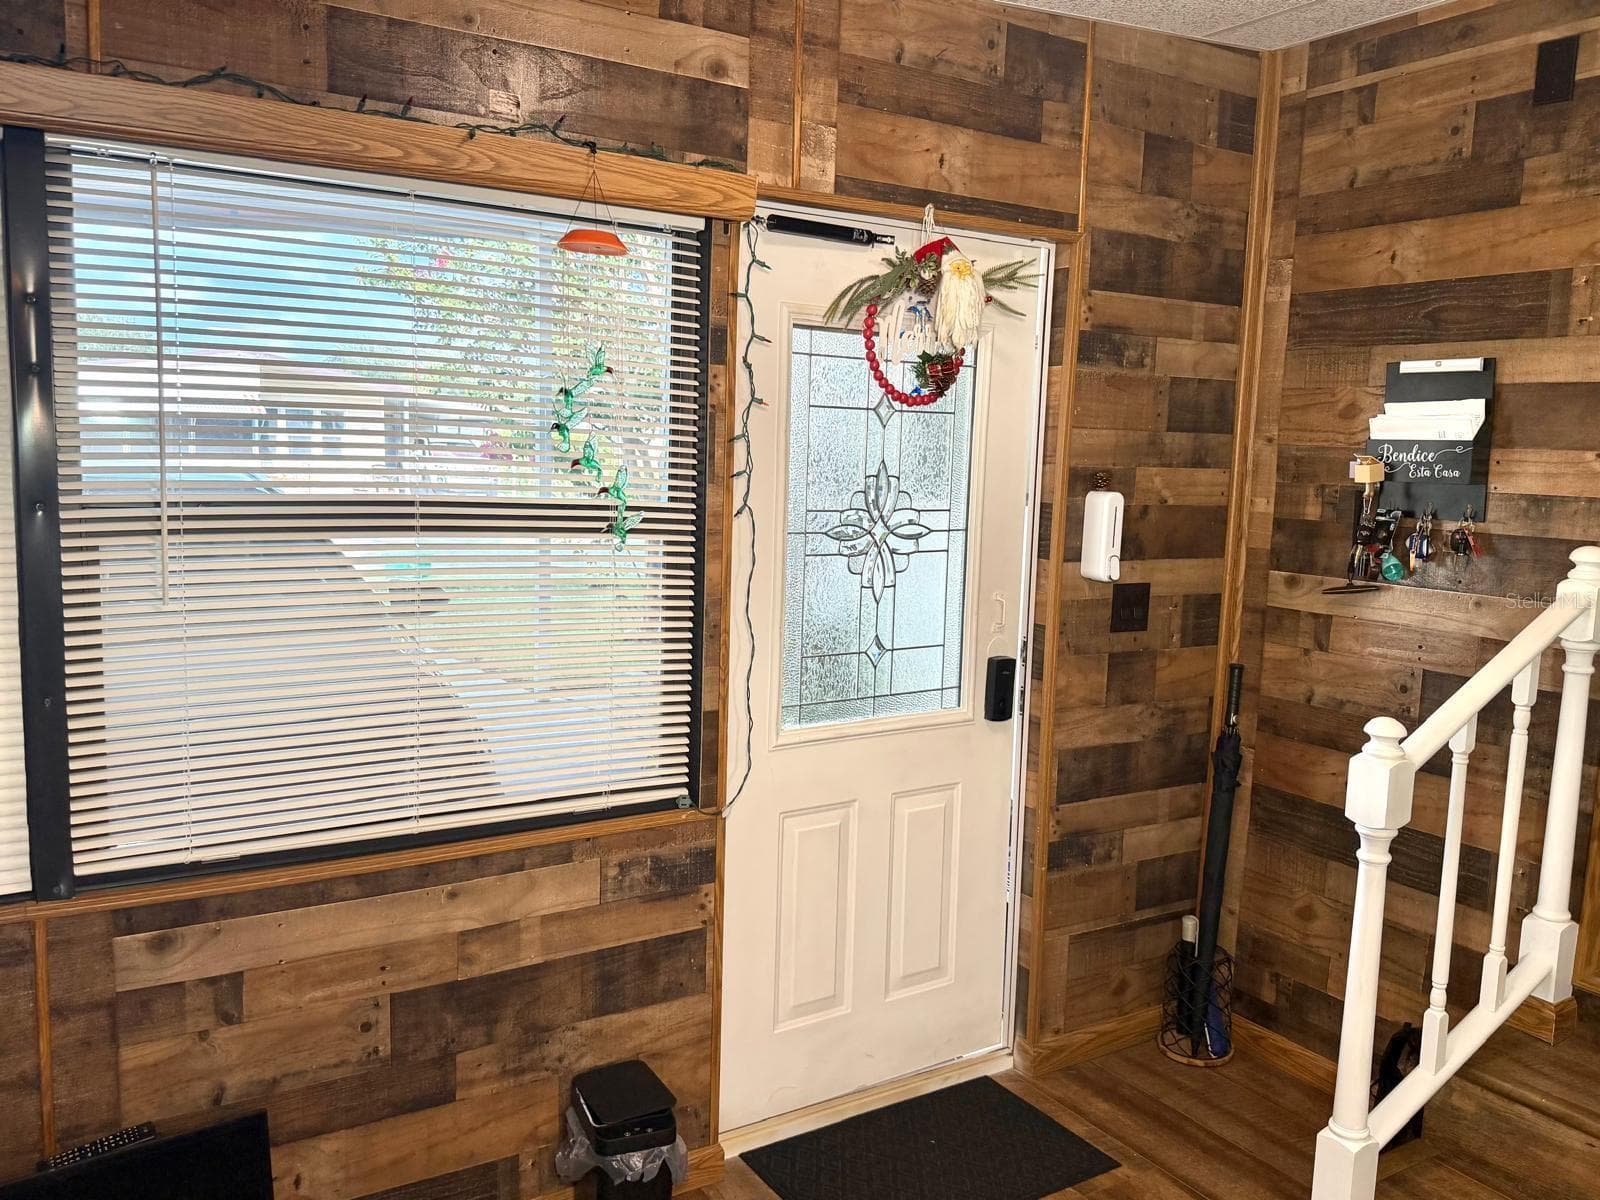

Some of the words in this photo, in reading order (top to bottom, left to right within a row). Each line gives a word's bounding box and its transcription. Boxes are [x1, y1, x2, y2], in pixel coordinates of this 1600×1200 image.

[1377, 443, 1441, 463] Bendice
[1407, 463, 1431, 478] Esta
[1433, 464, 1461, 478] Casa
